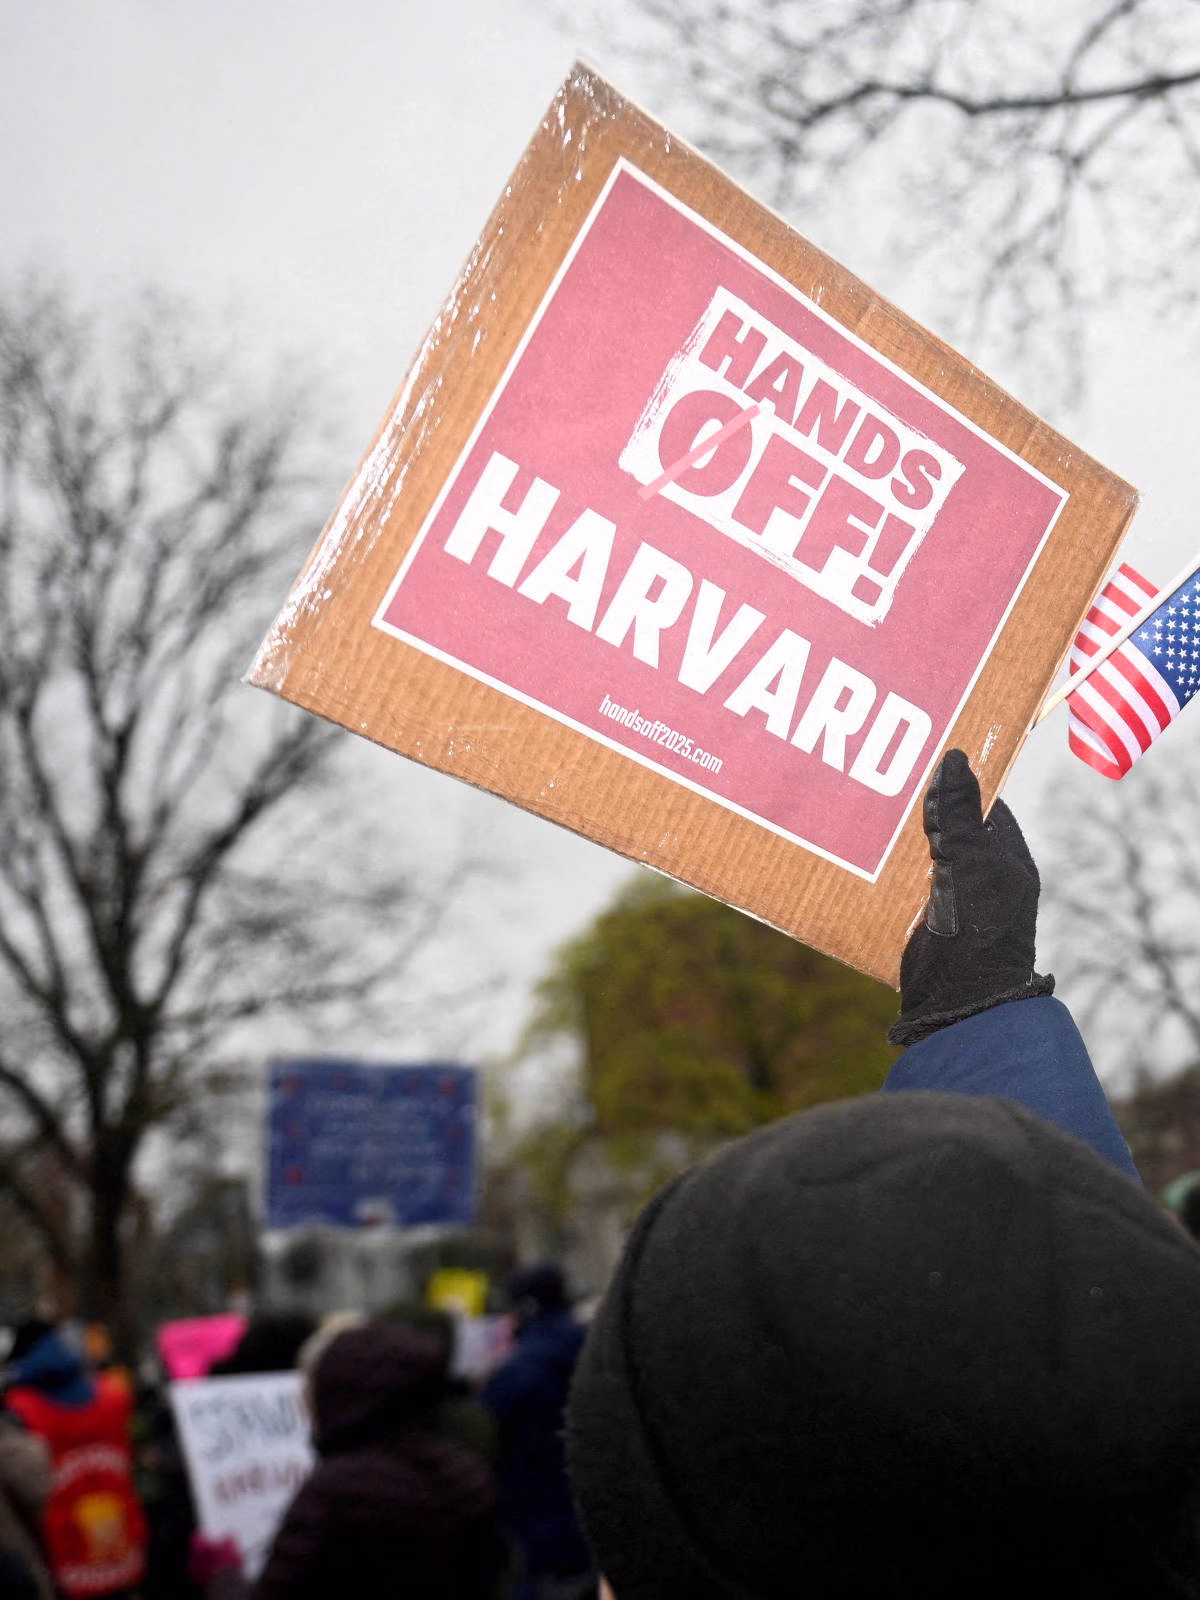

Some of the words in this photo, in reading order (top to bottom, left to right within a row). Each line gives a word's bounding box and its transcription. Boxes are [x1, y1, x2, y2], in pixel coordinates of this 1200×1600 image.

[658, 391, 912, 609] OFF!
[698, 307, 942, 512] HANDS
[445, 452, 932, 797] HARVARD
[598, 693, 723, 774] handsoff2025.com
